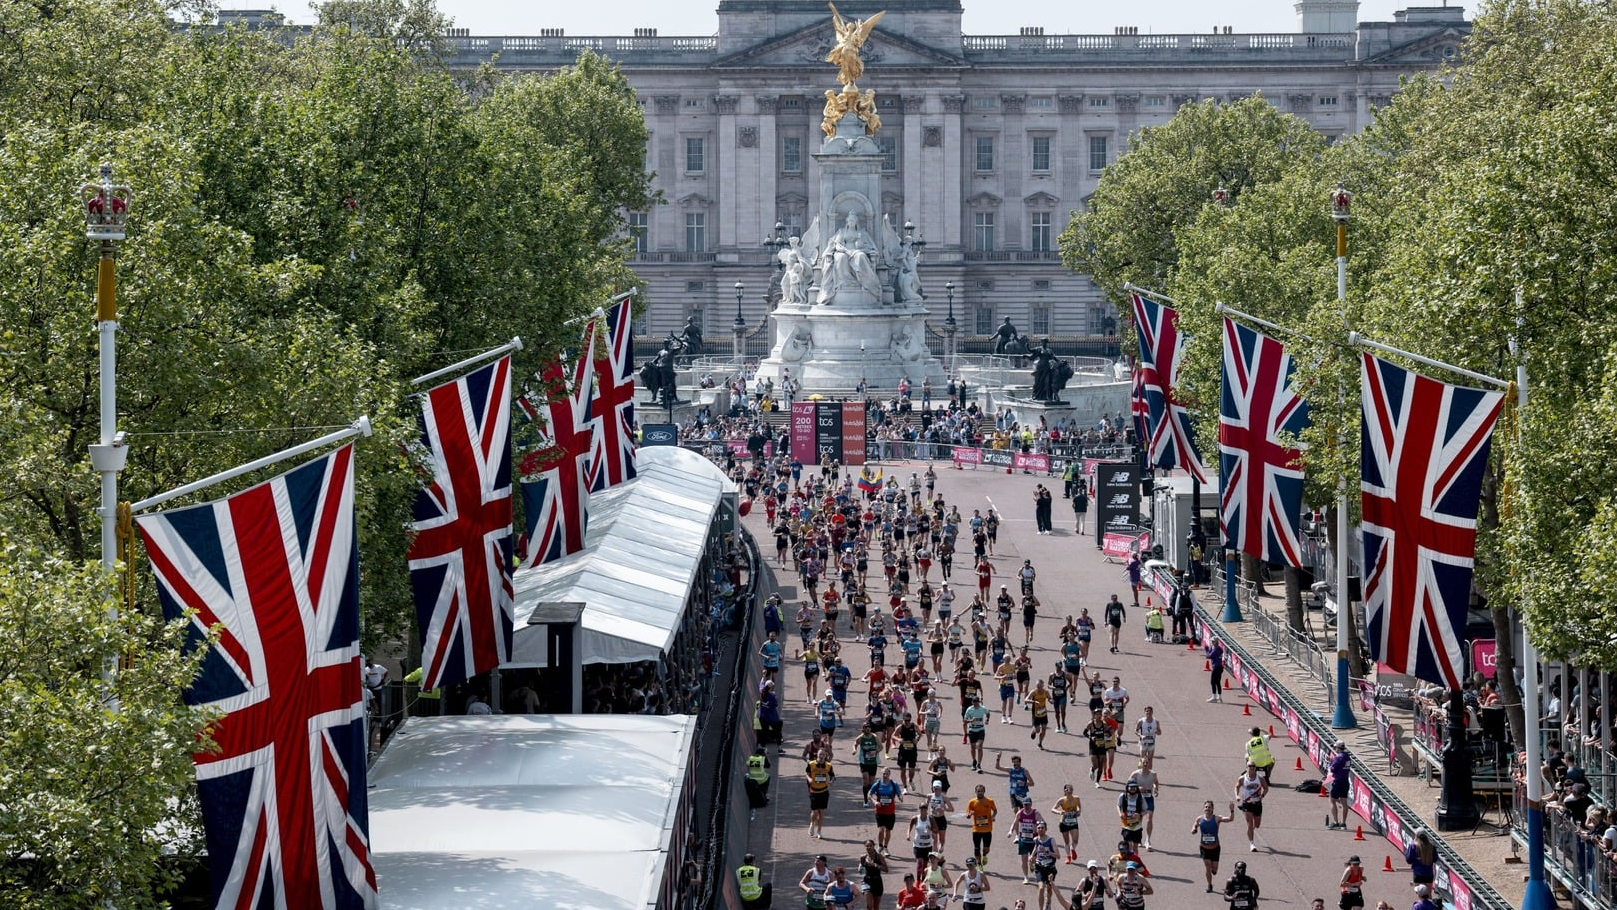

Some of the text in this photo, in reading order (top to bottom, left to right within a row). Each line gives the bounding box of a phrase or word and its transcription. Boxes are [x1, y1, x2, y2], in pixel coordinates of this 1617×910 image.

[819, 417, 834, 426] tcs
[819, 444, 834, 454] tcs
[1482, 652, 1496, 666] tc
[1378, 682, 1392, 696] tcs
